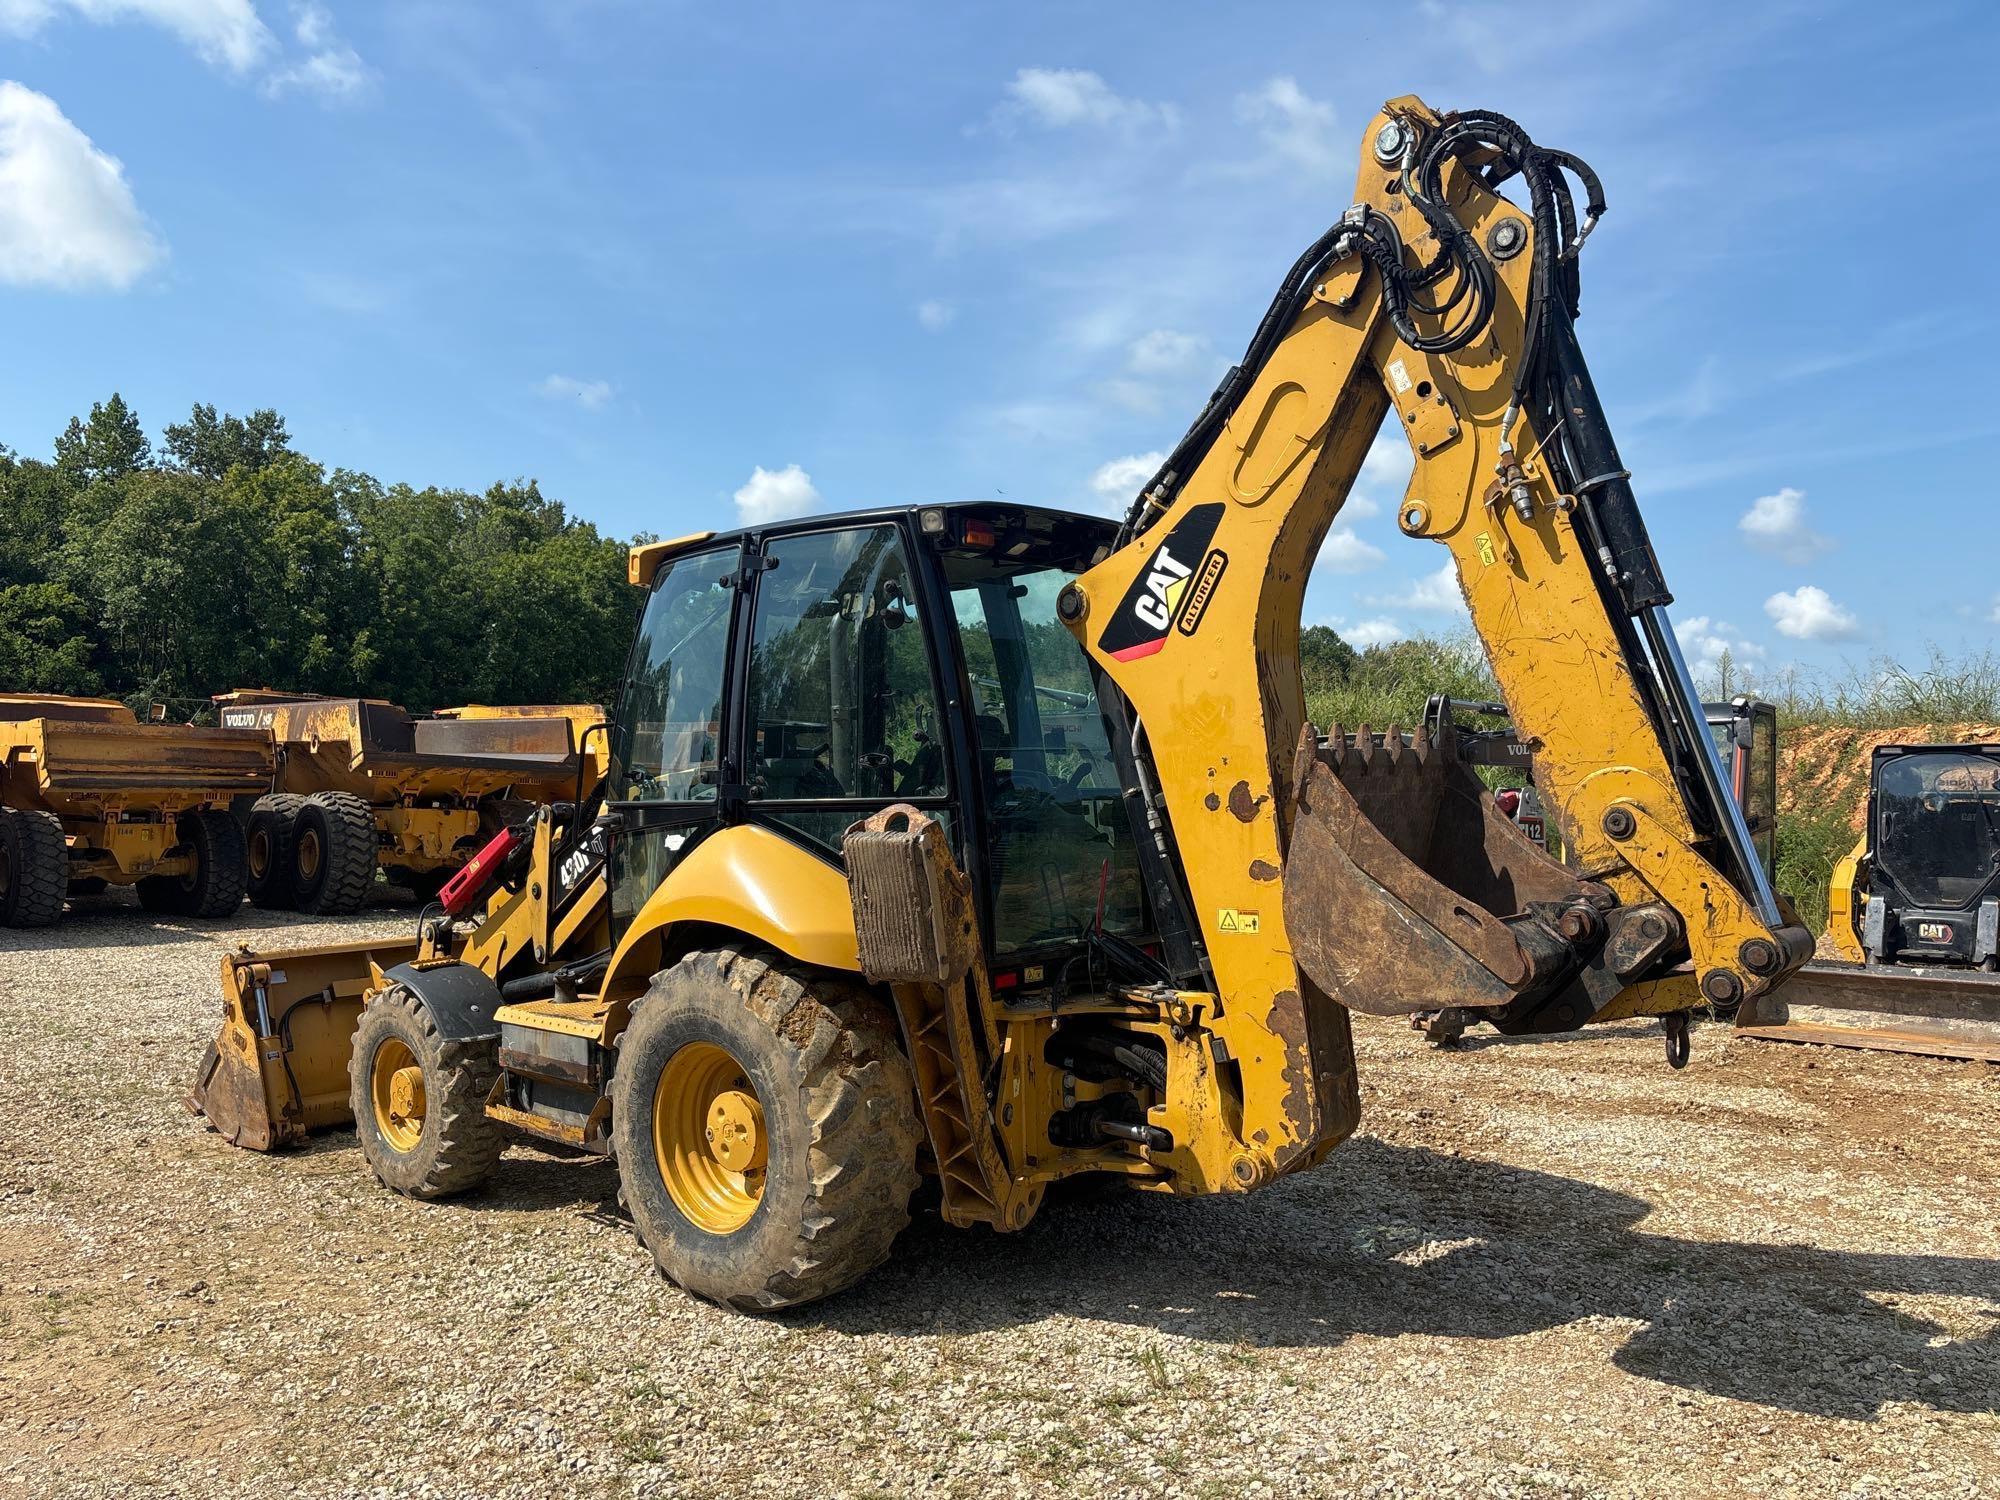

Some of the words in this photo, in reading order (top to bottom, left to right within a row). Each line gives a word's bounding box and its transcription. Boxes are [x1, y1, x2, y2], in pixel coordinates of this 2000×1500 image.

[1134, 546, 1193, 631] CAT
[1186, 559, 1221, 627] ALTORFER
[226, 714, 255, 727] VOLVO
[1507, 744, 1530, 756] VOL
[1920, 924, 1944, 939] CAT
